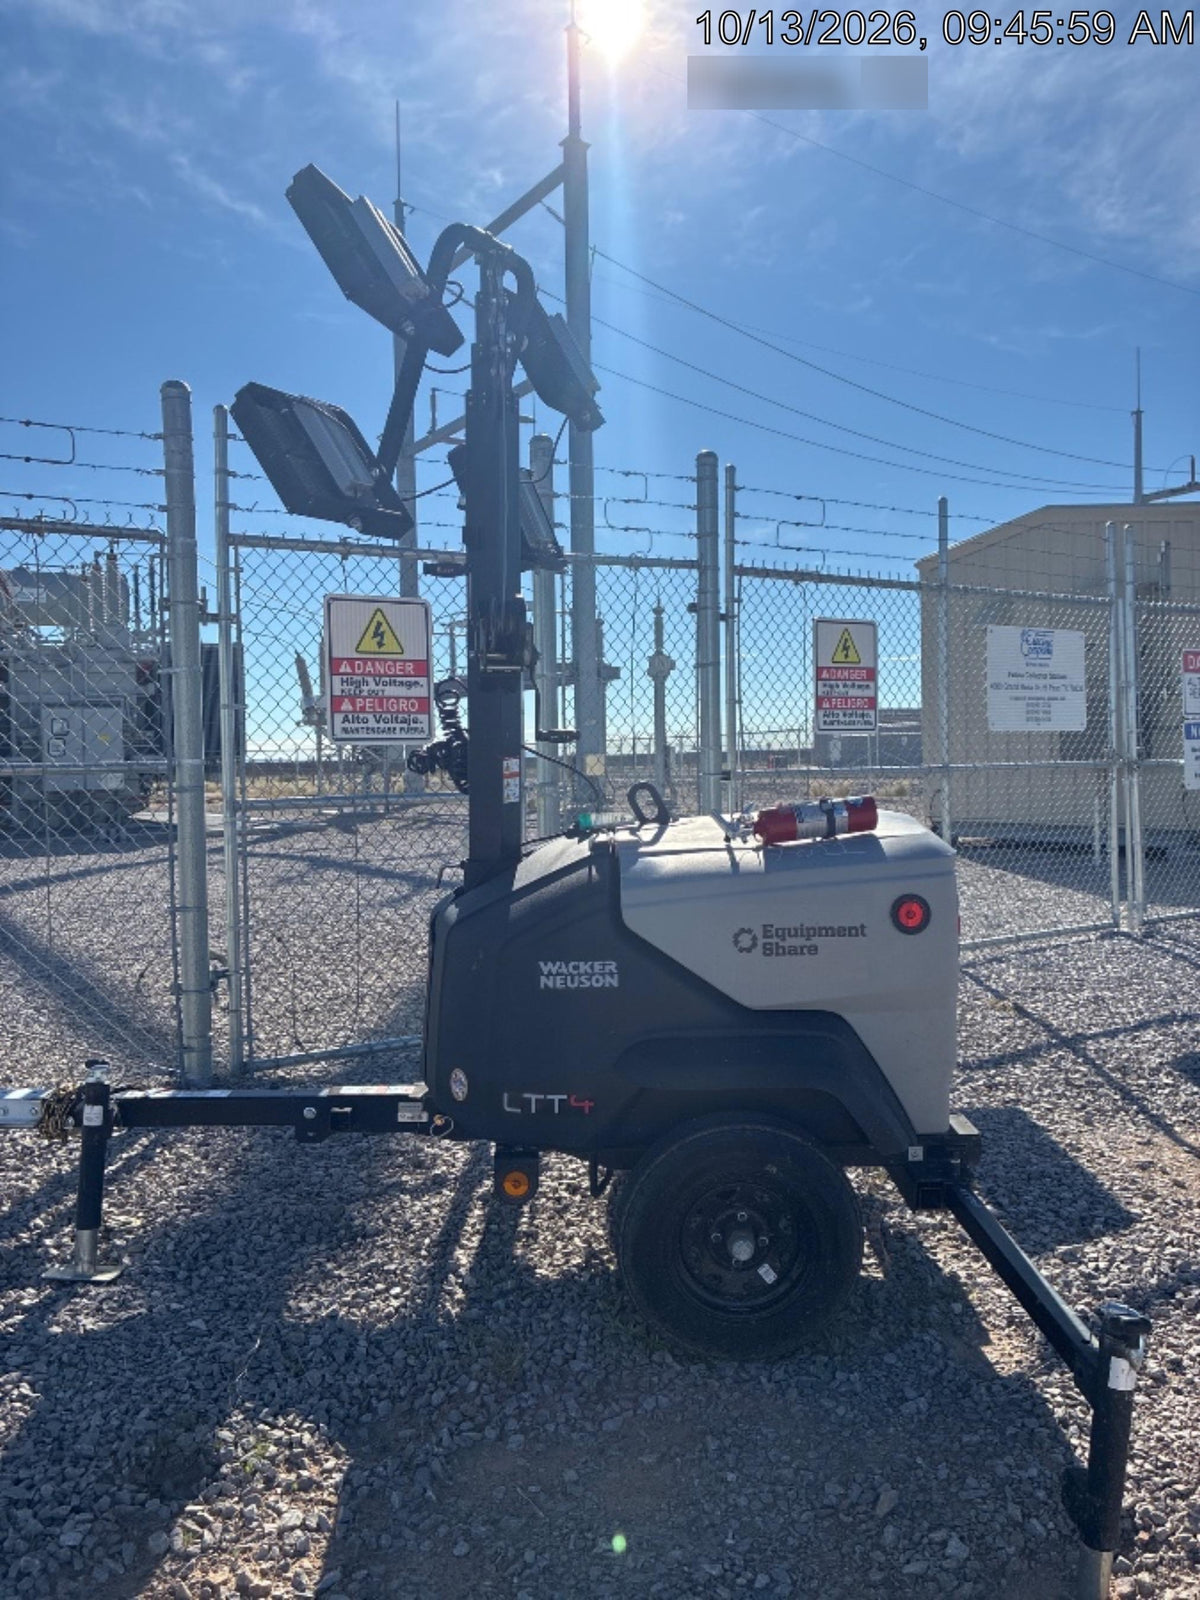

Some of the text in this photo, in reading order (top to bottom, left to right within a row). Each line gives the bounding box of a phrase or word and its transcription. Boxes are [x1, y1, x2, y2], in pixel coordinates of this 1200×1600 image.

[354, 660, 415, 675] DANGER
[830, 669, 867, 680] DANGER
[340, 676, 424, 690] High Voltage.
[340, 688, 386, 696] KEEP OUT
[356, 698, 419, 712] PELIGRO
[831, 698, 869, 709] PELIGRO
[341, 714, 424, 726] Alto Voltaje.
[762, 923, 867, 941] Equipment
[762, 942, 819, 957] Share
[538, 960, 618, 975] WACKER
[540, 974, 619, 989] NEUSON
[502, 1092, 595, 1115] LTT4
